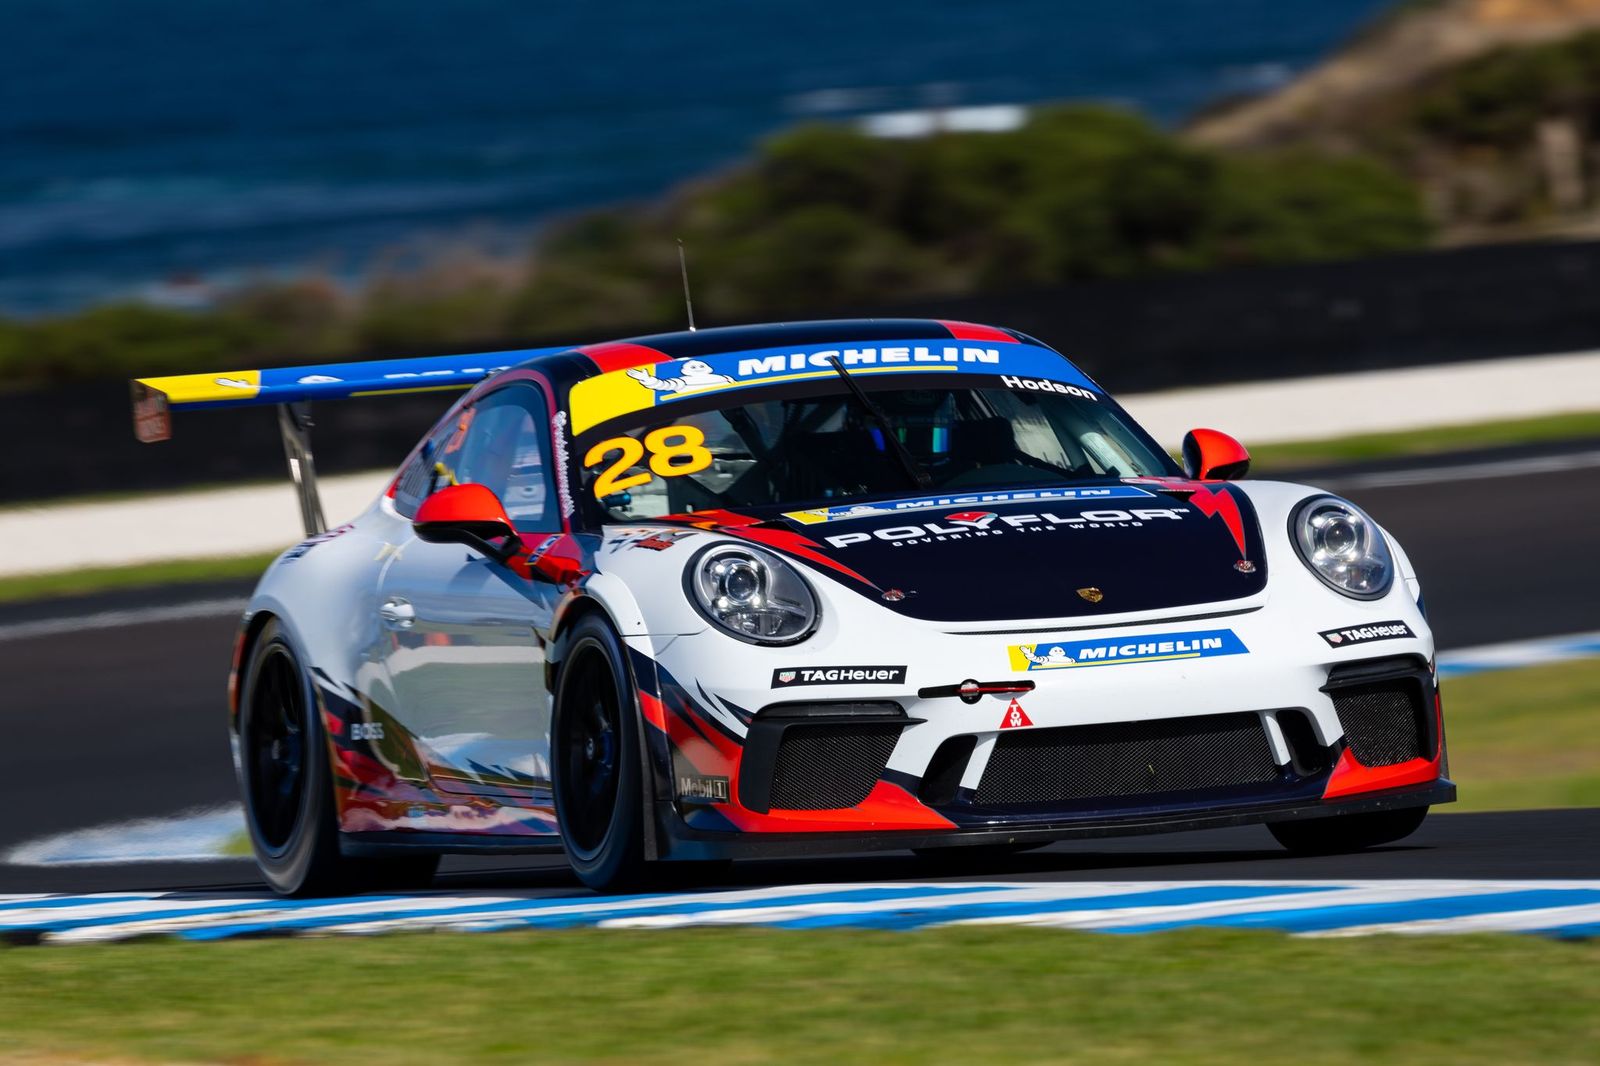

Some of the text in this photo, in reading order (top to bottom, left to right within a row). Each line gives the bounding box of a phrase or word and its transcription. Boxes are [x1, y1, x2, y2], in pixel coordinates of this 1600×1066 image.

[738, 347, 999, 376] MICHELIN
[1000, 375, 1098, 400] Hodson
[584, 425, 712, 499] 28
[896, 489, 1111, 509] MICHELIN
[892, 521, 1143, 547] COVERING THE WORLD
[1078, 637, 1222, 660] MICHELIN
[1010, 704, 1022, 727] TOW
[351, 722, 385, 740] BOSS
[680, 778, 713, 798] Mobil
